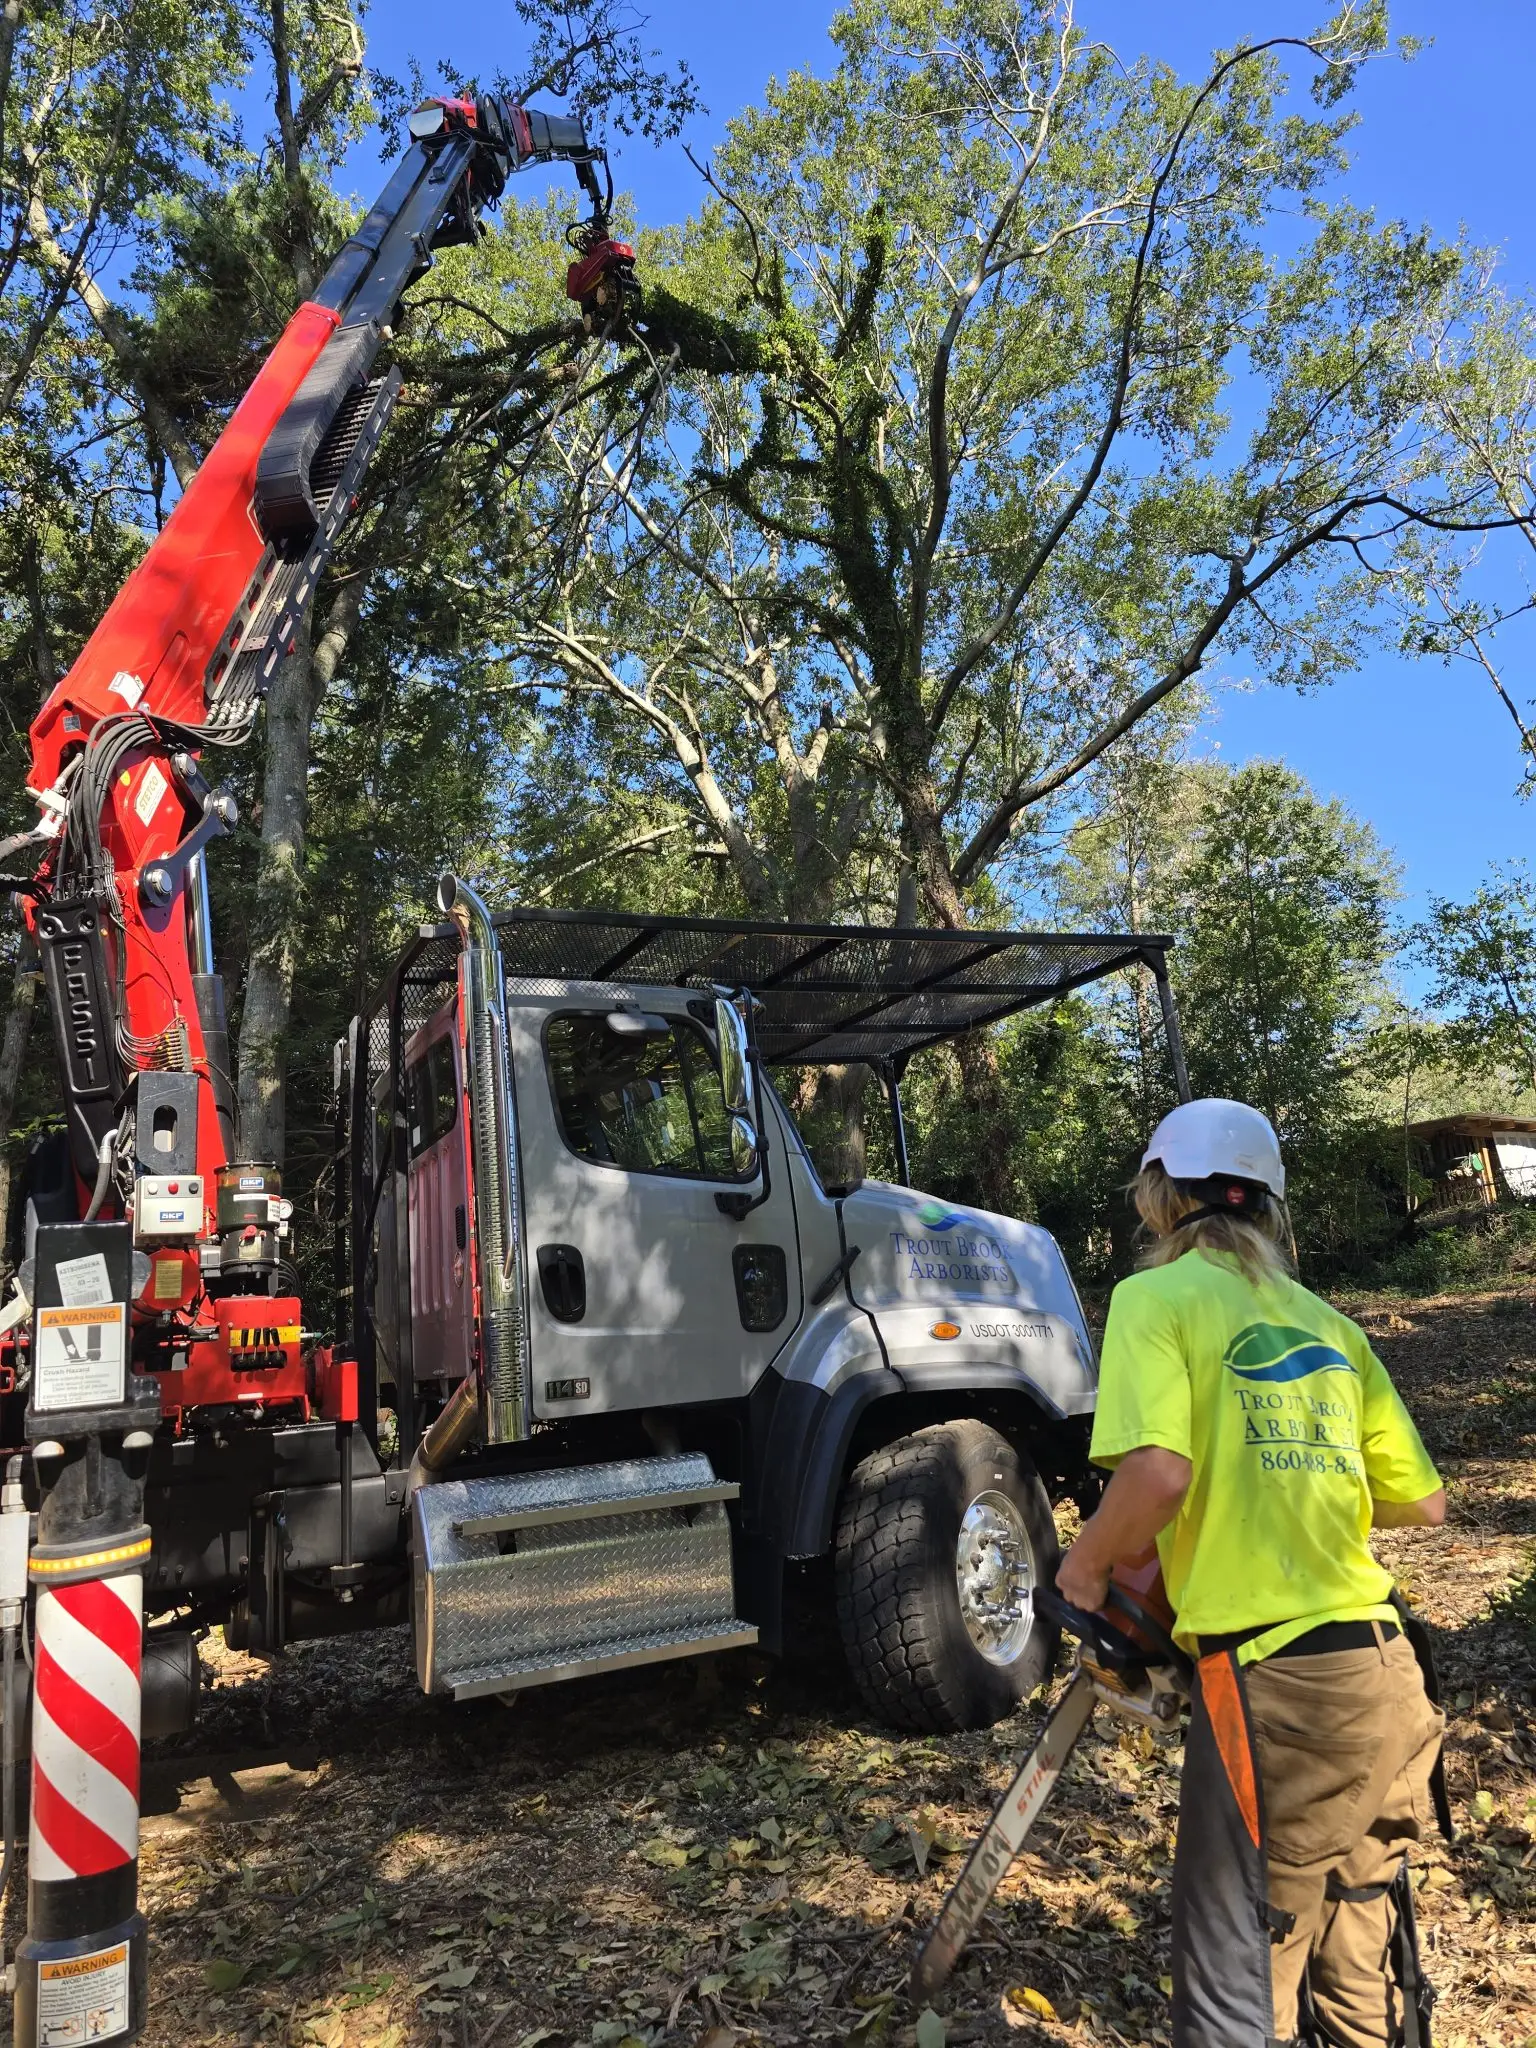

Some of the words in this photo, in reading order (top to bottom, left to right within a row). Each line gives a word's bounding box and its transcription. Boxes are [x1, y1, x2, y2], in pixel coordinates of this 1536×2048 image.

[62, 944, 97, 1085] FASSI
[889, 1232, 951, 1256] TROUT
[956, 1237, 1014, 1260] BROOK
[908, 1257, 1009, 1282] ARBORISTS
[61, 1310, 116, 1322] WARNING
[970, 1324, 1012, 1338] USDOT
[1013, 1324, 1054, 1339] 3001771
[575, 1381, 588, 1394] SD
[1016, 1751, 1056, 1817] STIHL
[61, 1954, 118, 1975] WARNING
